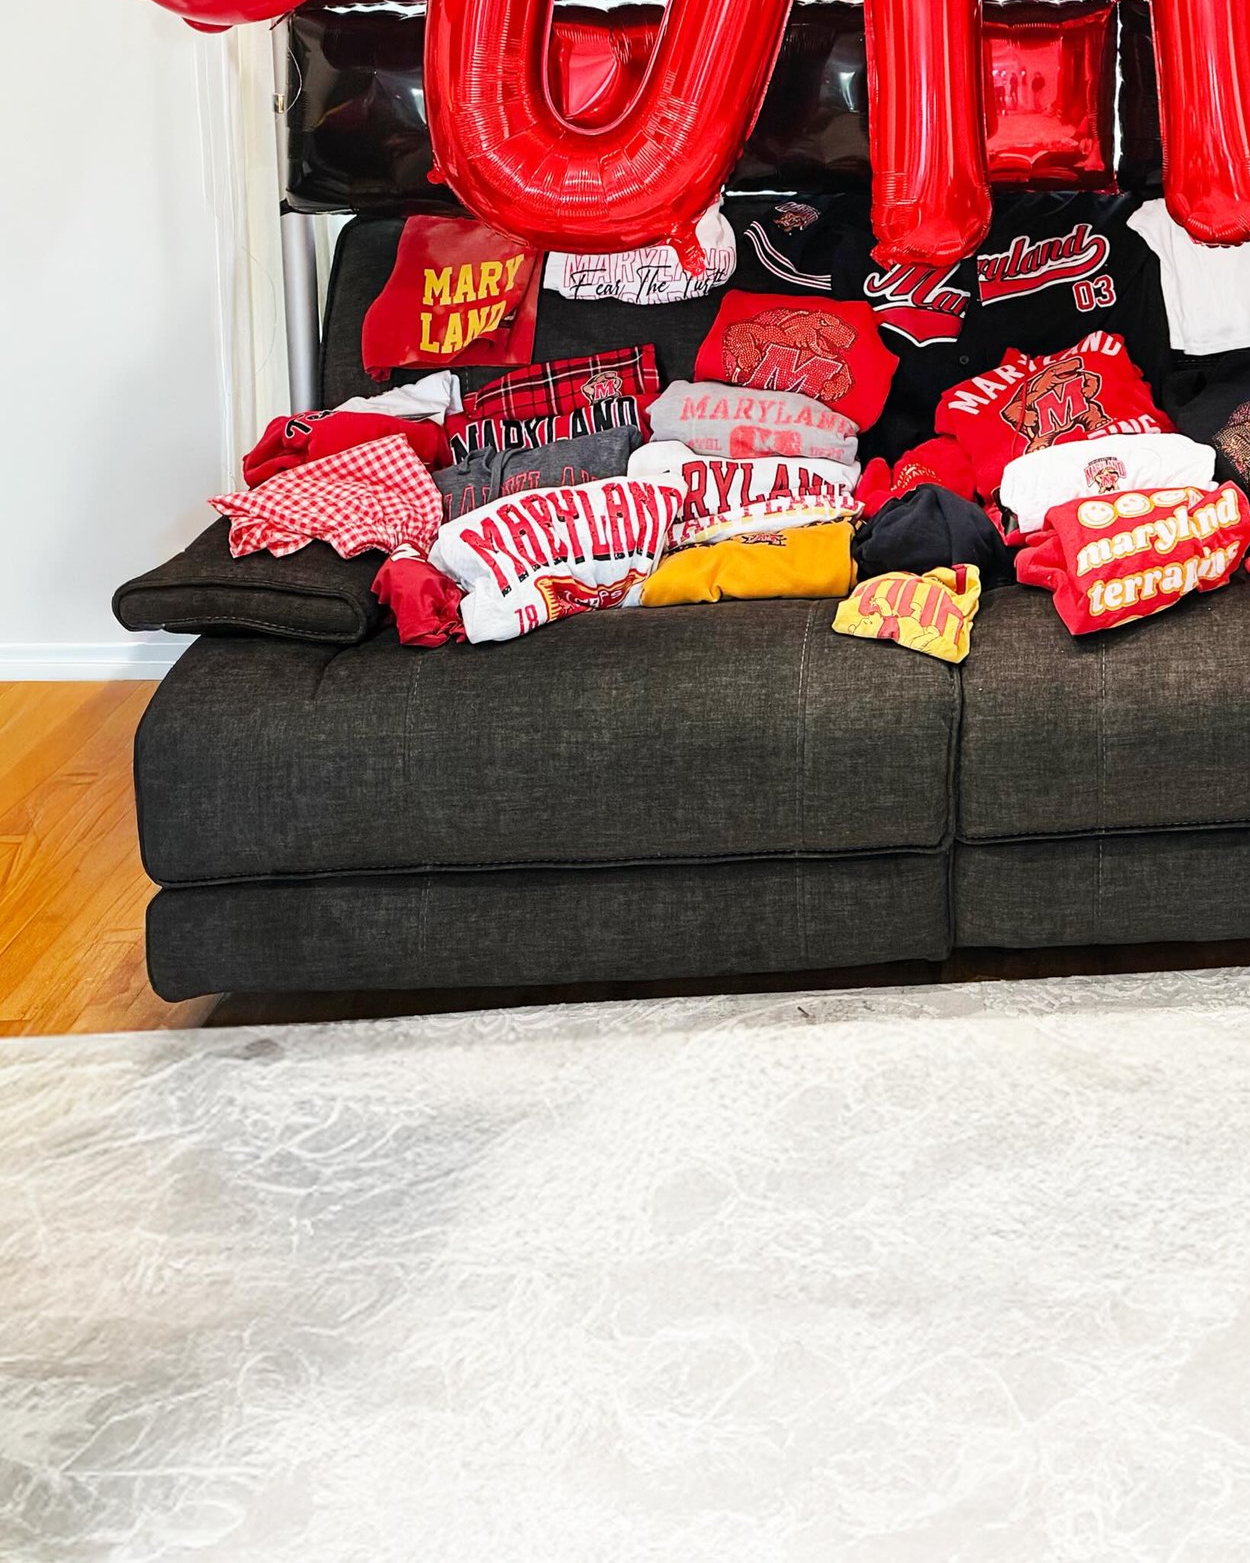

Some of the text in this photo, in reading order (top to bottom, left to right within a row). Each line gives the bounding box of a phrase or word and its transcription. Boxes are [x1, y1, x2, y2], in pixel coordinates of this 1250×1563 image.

[423, 253, 525, 306] MARY
[571, 268, 625, 300] Fear
[636, 265, 672, 304] The
[1072, 275, 1118, 312] 03
[420, 300, 507, 354] LAND
[594, 381, 616, 399] M
[1036, 375, 1090, 437] M
[459, 480, 685, 598] MARYLAND
